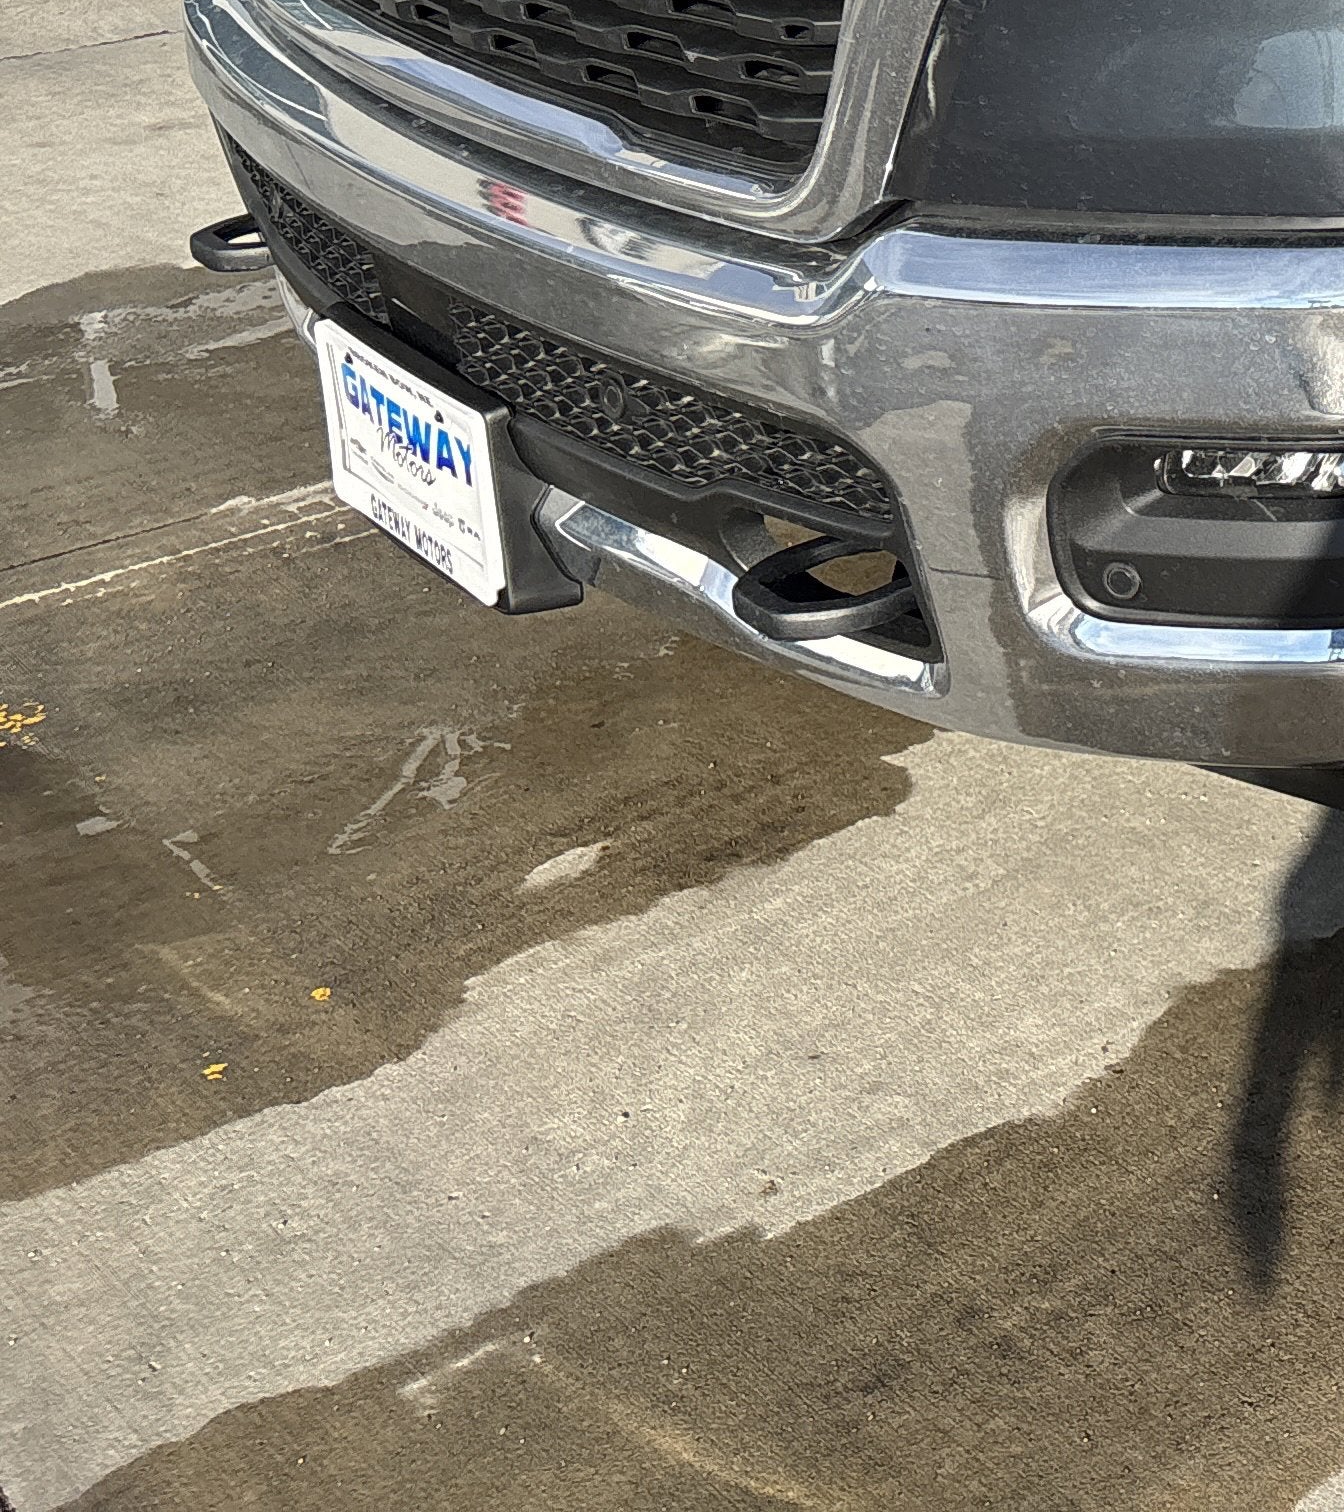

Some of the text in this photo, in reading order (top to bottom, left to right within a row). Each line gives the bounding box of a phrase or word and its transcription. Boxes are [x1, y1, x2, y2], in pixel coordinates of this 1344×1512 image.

[340, 362, 473, 488] GATEWAY
[376, 426, 438, 488] Motors
[370, 493, 412, 544] GATEWAY
[413, 524, 454, 575] MOTORS
